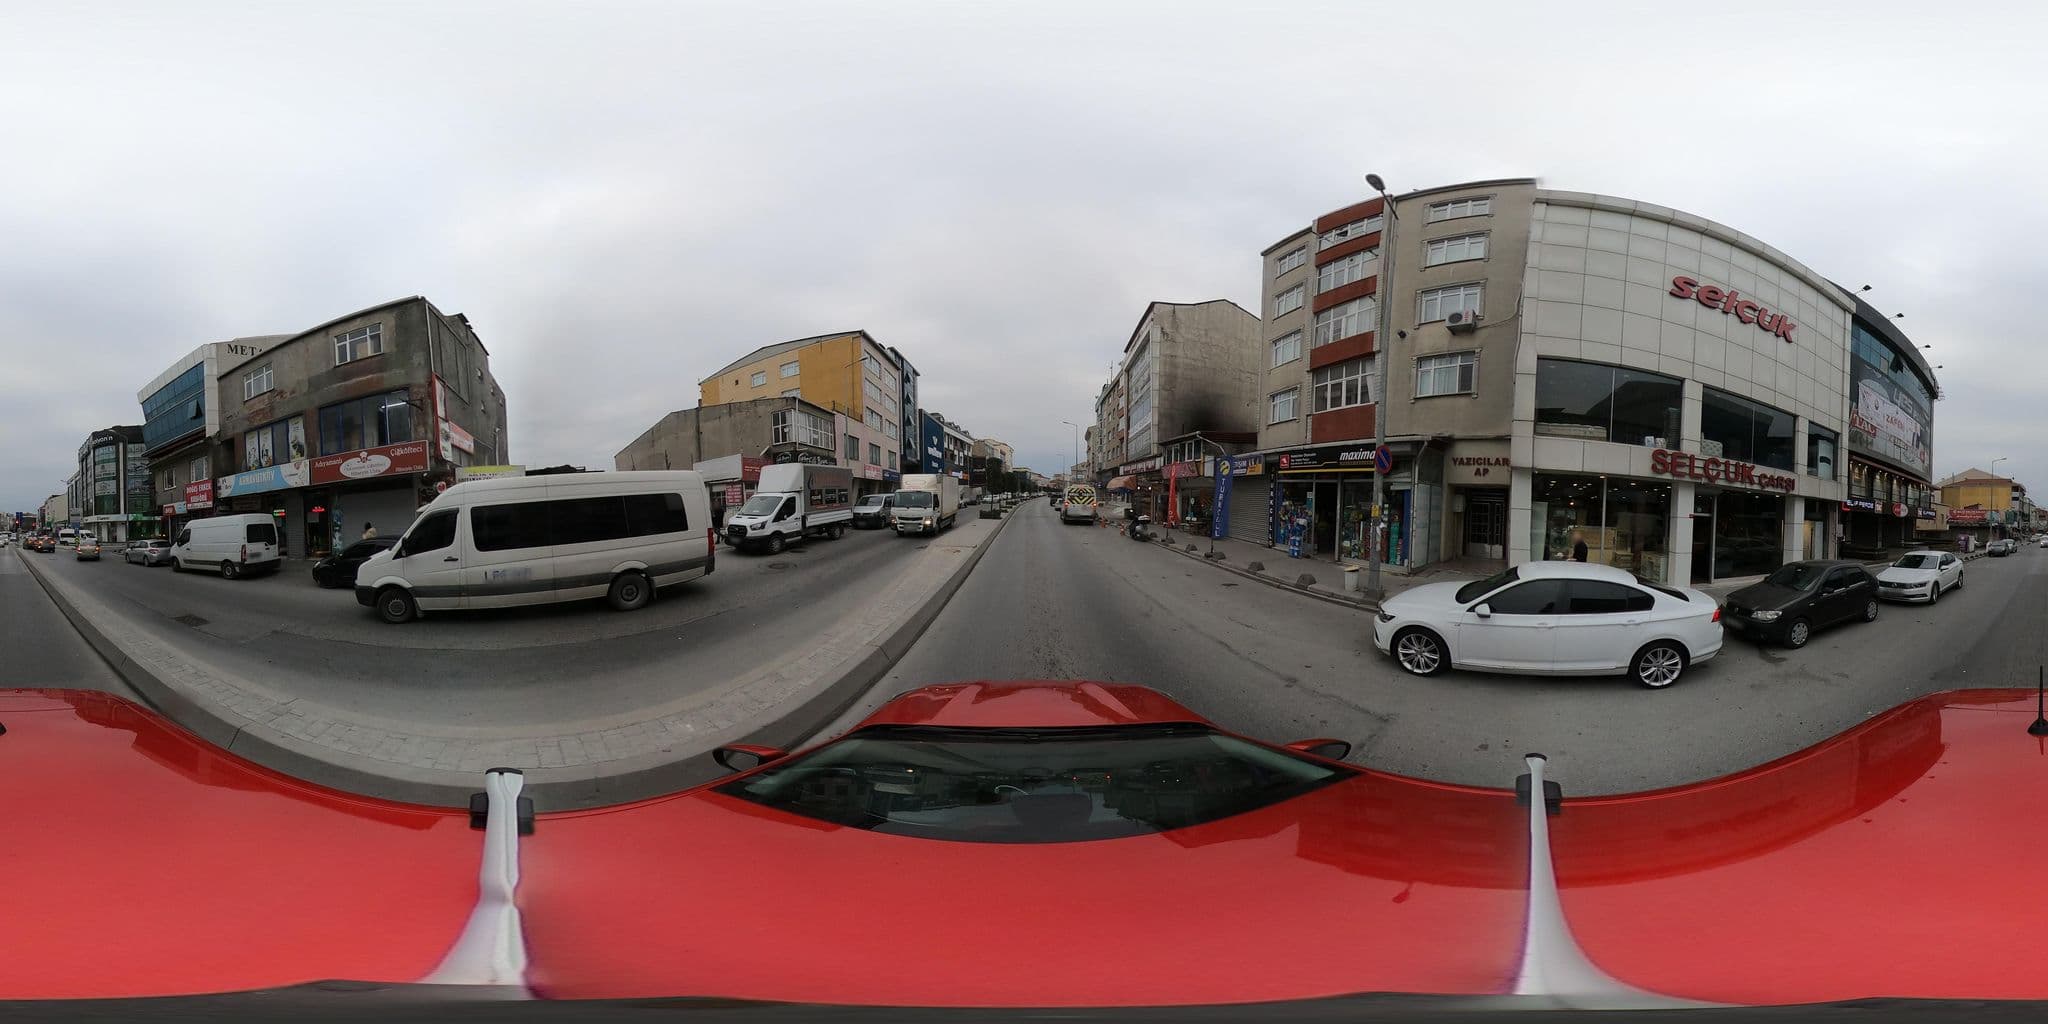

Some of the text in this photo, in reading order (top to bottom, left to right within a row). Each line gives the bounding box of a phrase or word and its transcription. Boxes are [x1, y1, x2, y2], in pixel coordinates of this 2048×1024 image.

[1669, 276, 1796, 343] selçuk
[1452, 457, 1510, 466] YAZICILAR
[1474, 468, 1489, 477] AP
[1652, 449, 1795, 493] SELÇUK ÇARŞI
